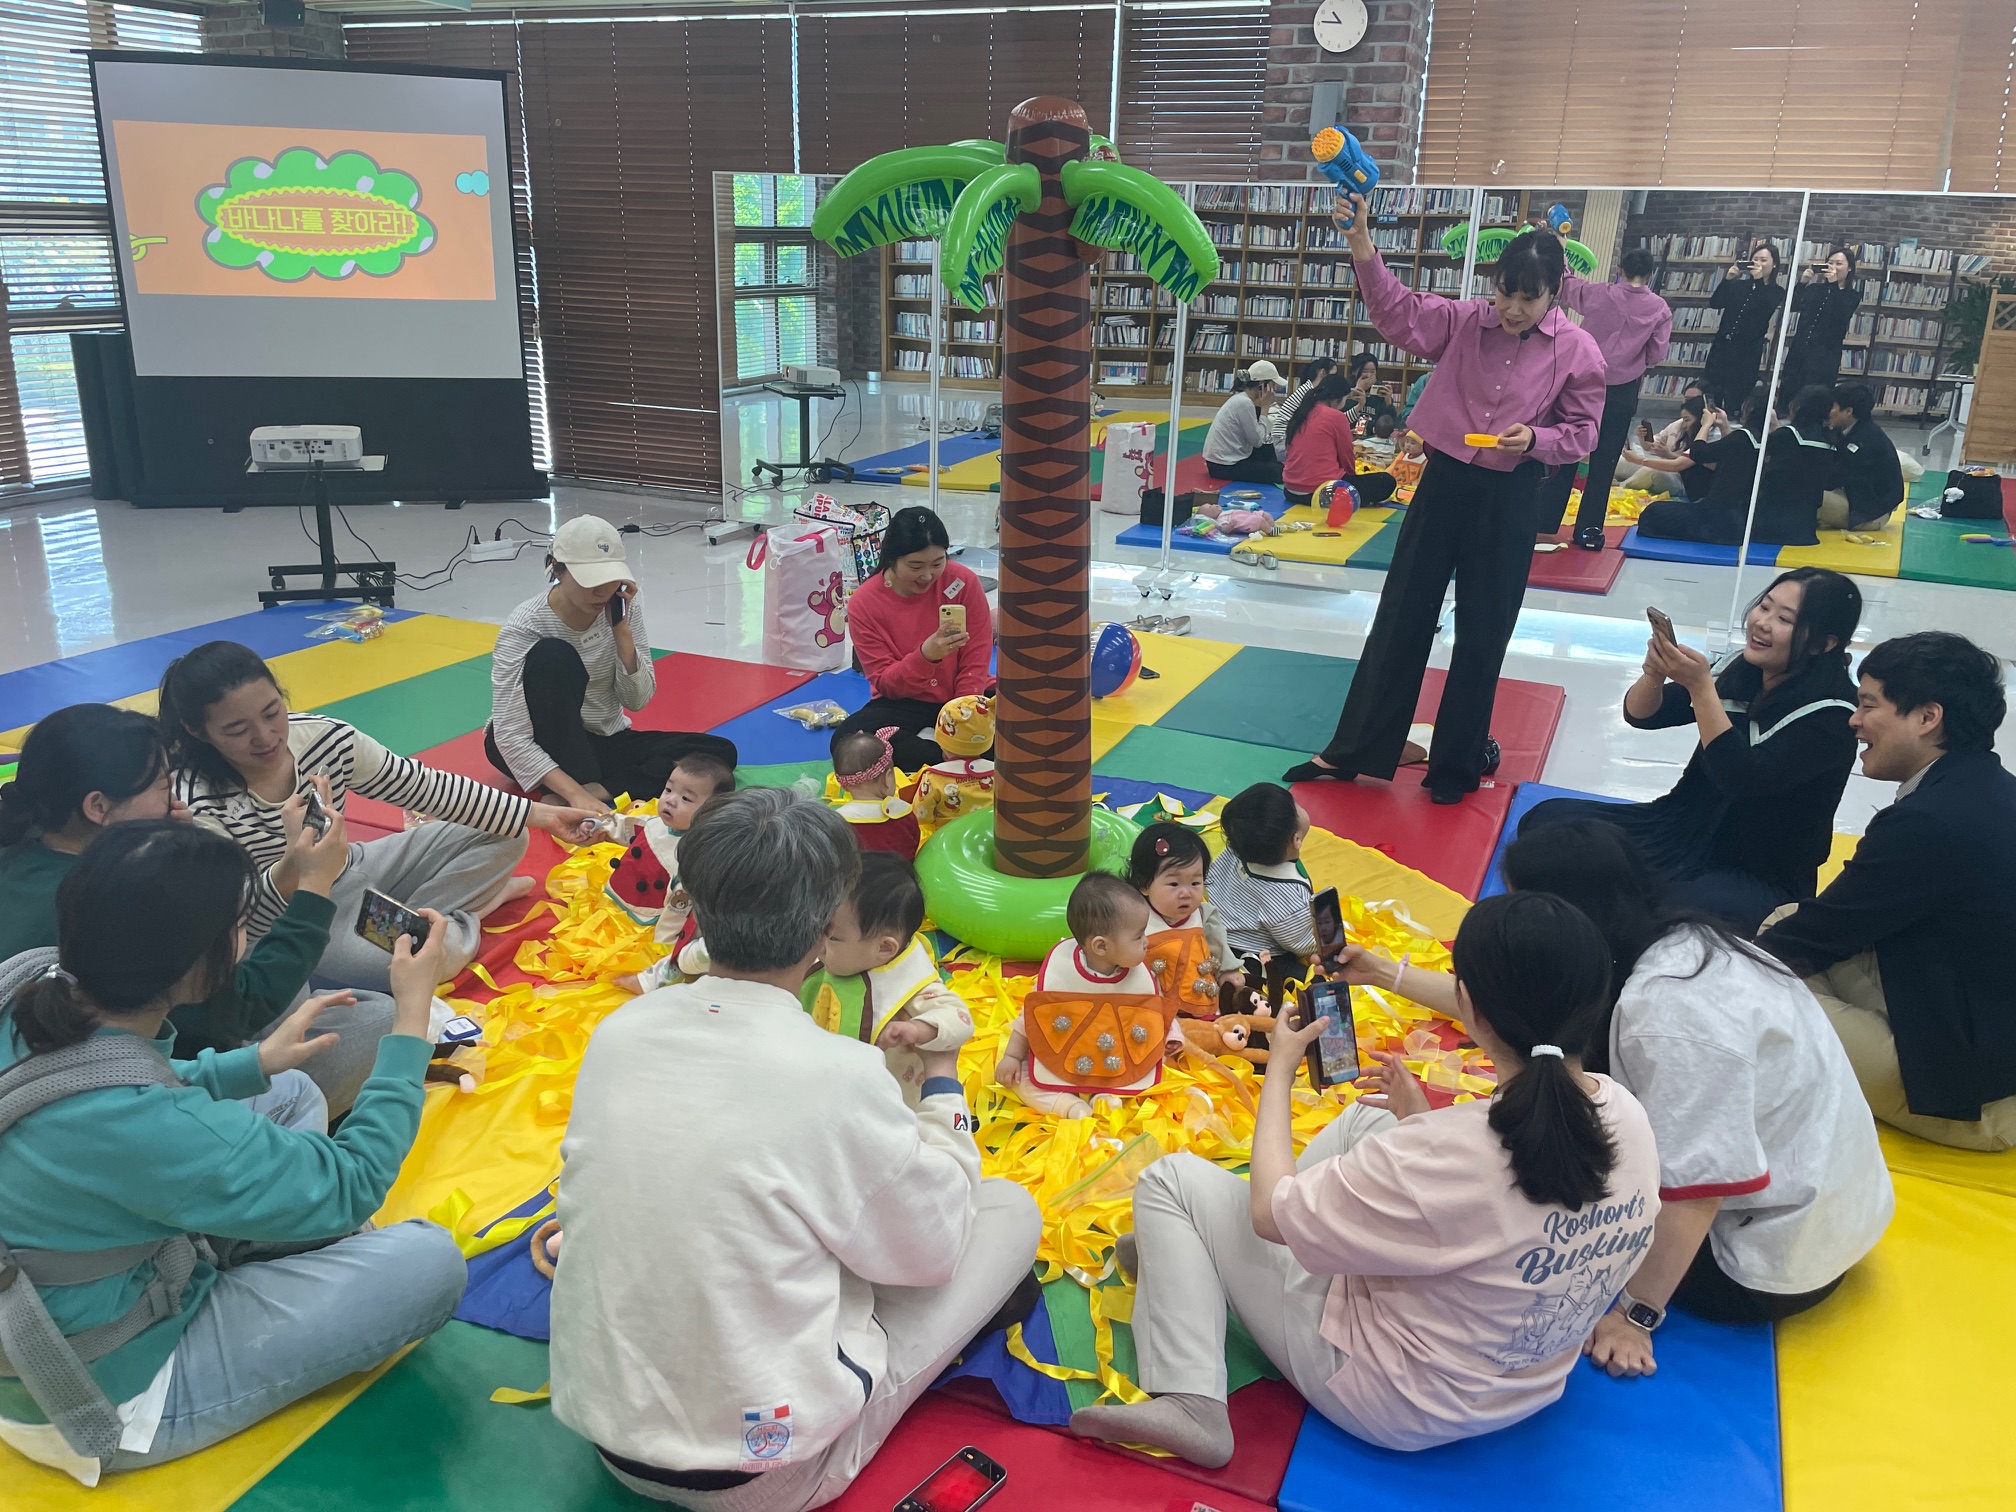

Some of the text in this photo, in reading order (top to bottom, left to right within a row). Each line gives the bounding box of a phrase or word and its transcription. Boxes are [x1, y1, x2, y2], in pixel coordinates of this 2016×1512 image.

[228, 205, 407, 236] 바나나를 찾아라!
[1543, 1189, 1645, 1244] Koshort's
[1515, 1225, 1653, 1285] Busking
